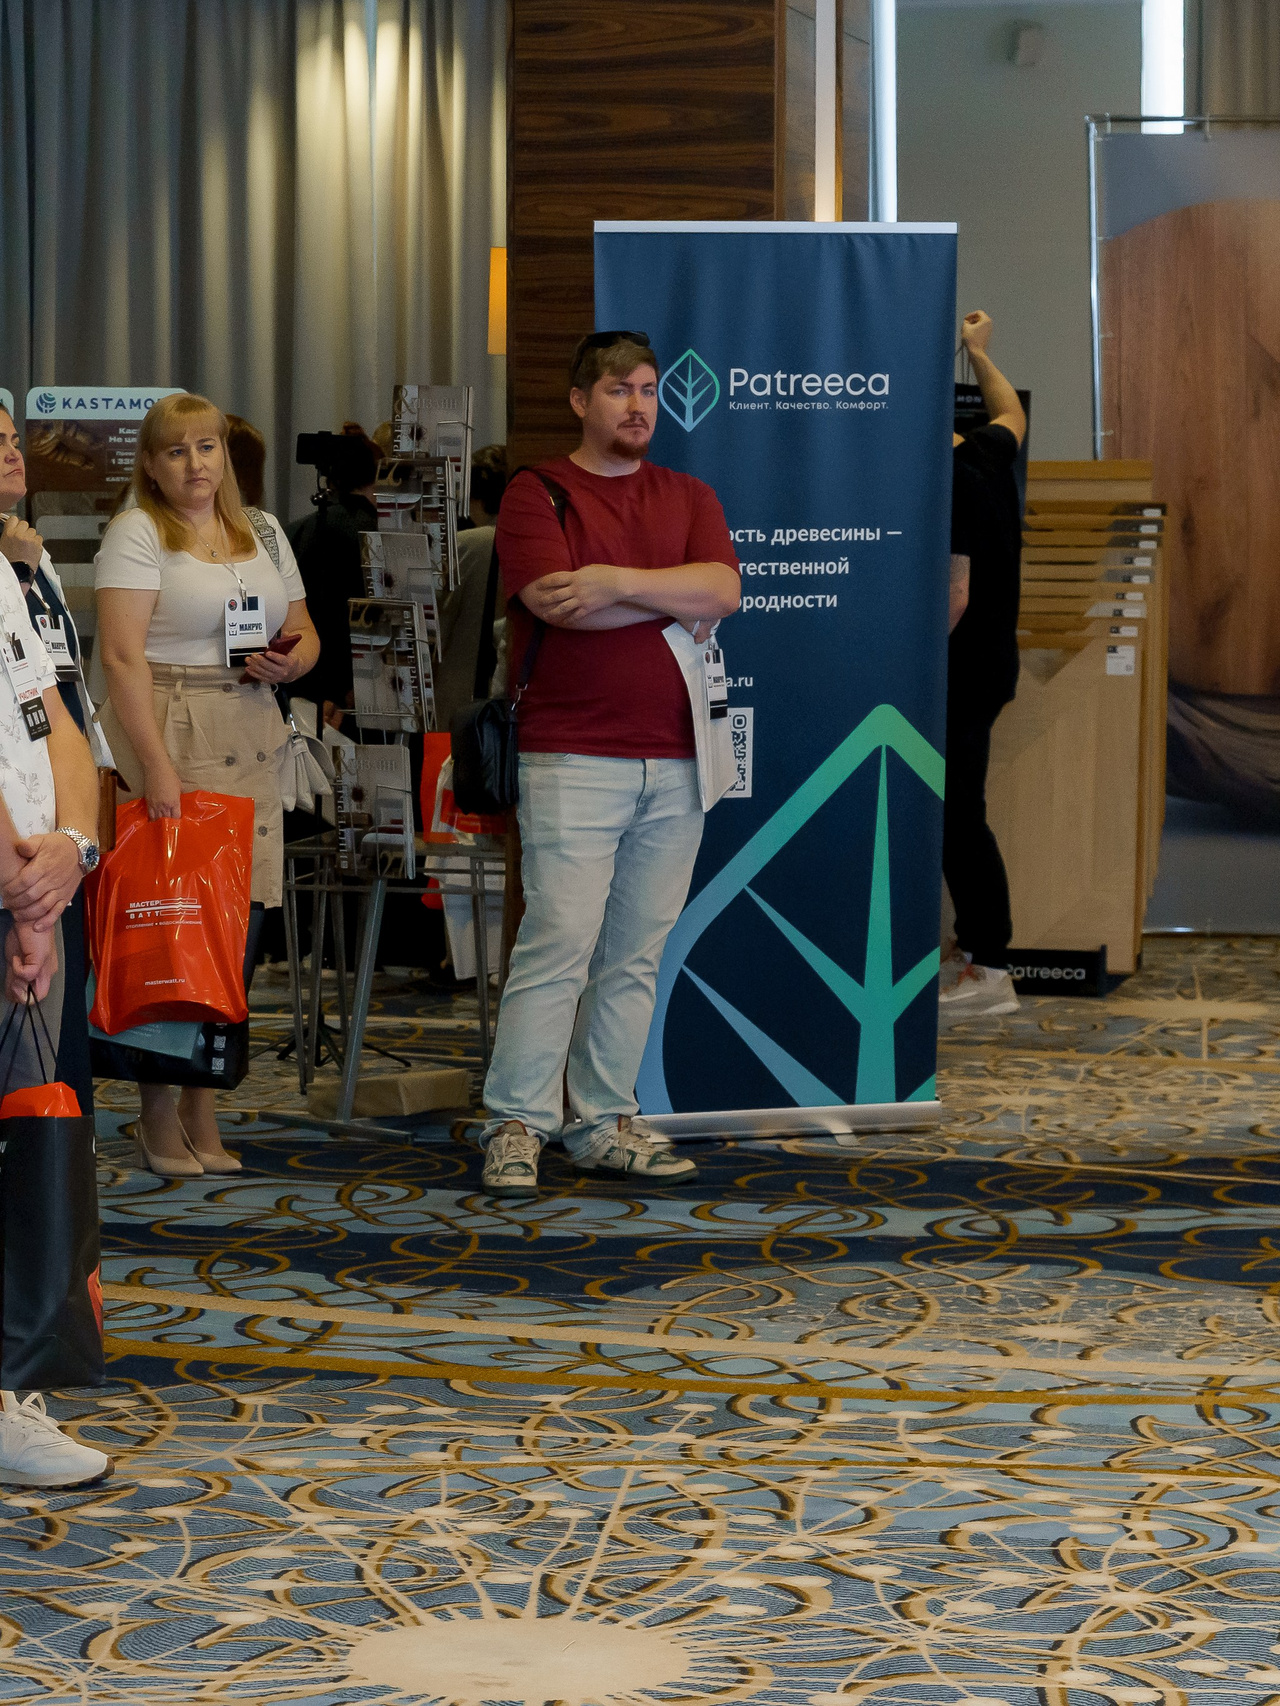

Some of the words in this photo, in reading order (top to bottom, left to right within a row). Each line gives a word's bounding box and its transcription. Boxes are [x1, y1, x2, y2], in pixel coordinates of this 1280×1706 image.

[730, 368, 889, 396] Patreeca
[62, 398, 160, 410] KASTAMO
[729, 401, 771, 410] Клиент.
[776, 401, 832, 410] Качество.
[836, 401, 889, 411] Комфорт.
[771, 527, 881, 546] древесины
[739, 594, 838, 612] родности
[726, 676, 754, 688] a.ru
[130, 900, 160, 908] МАСТЕР
[144, 978, 186, 986] masterwatt.ru
